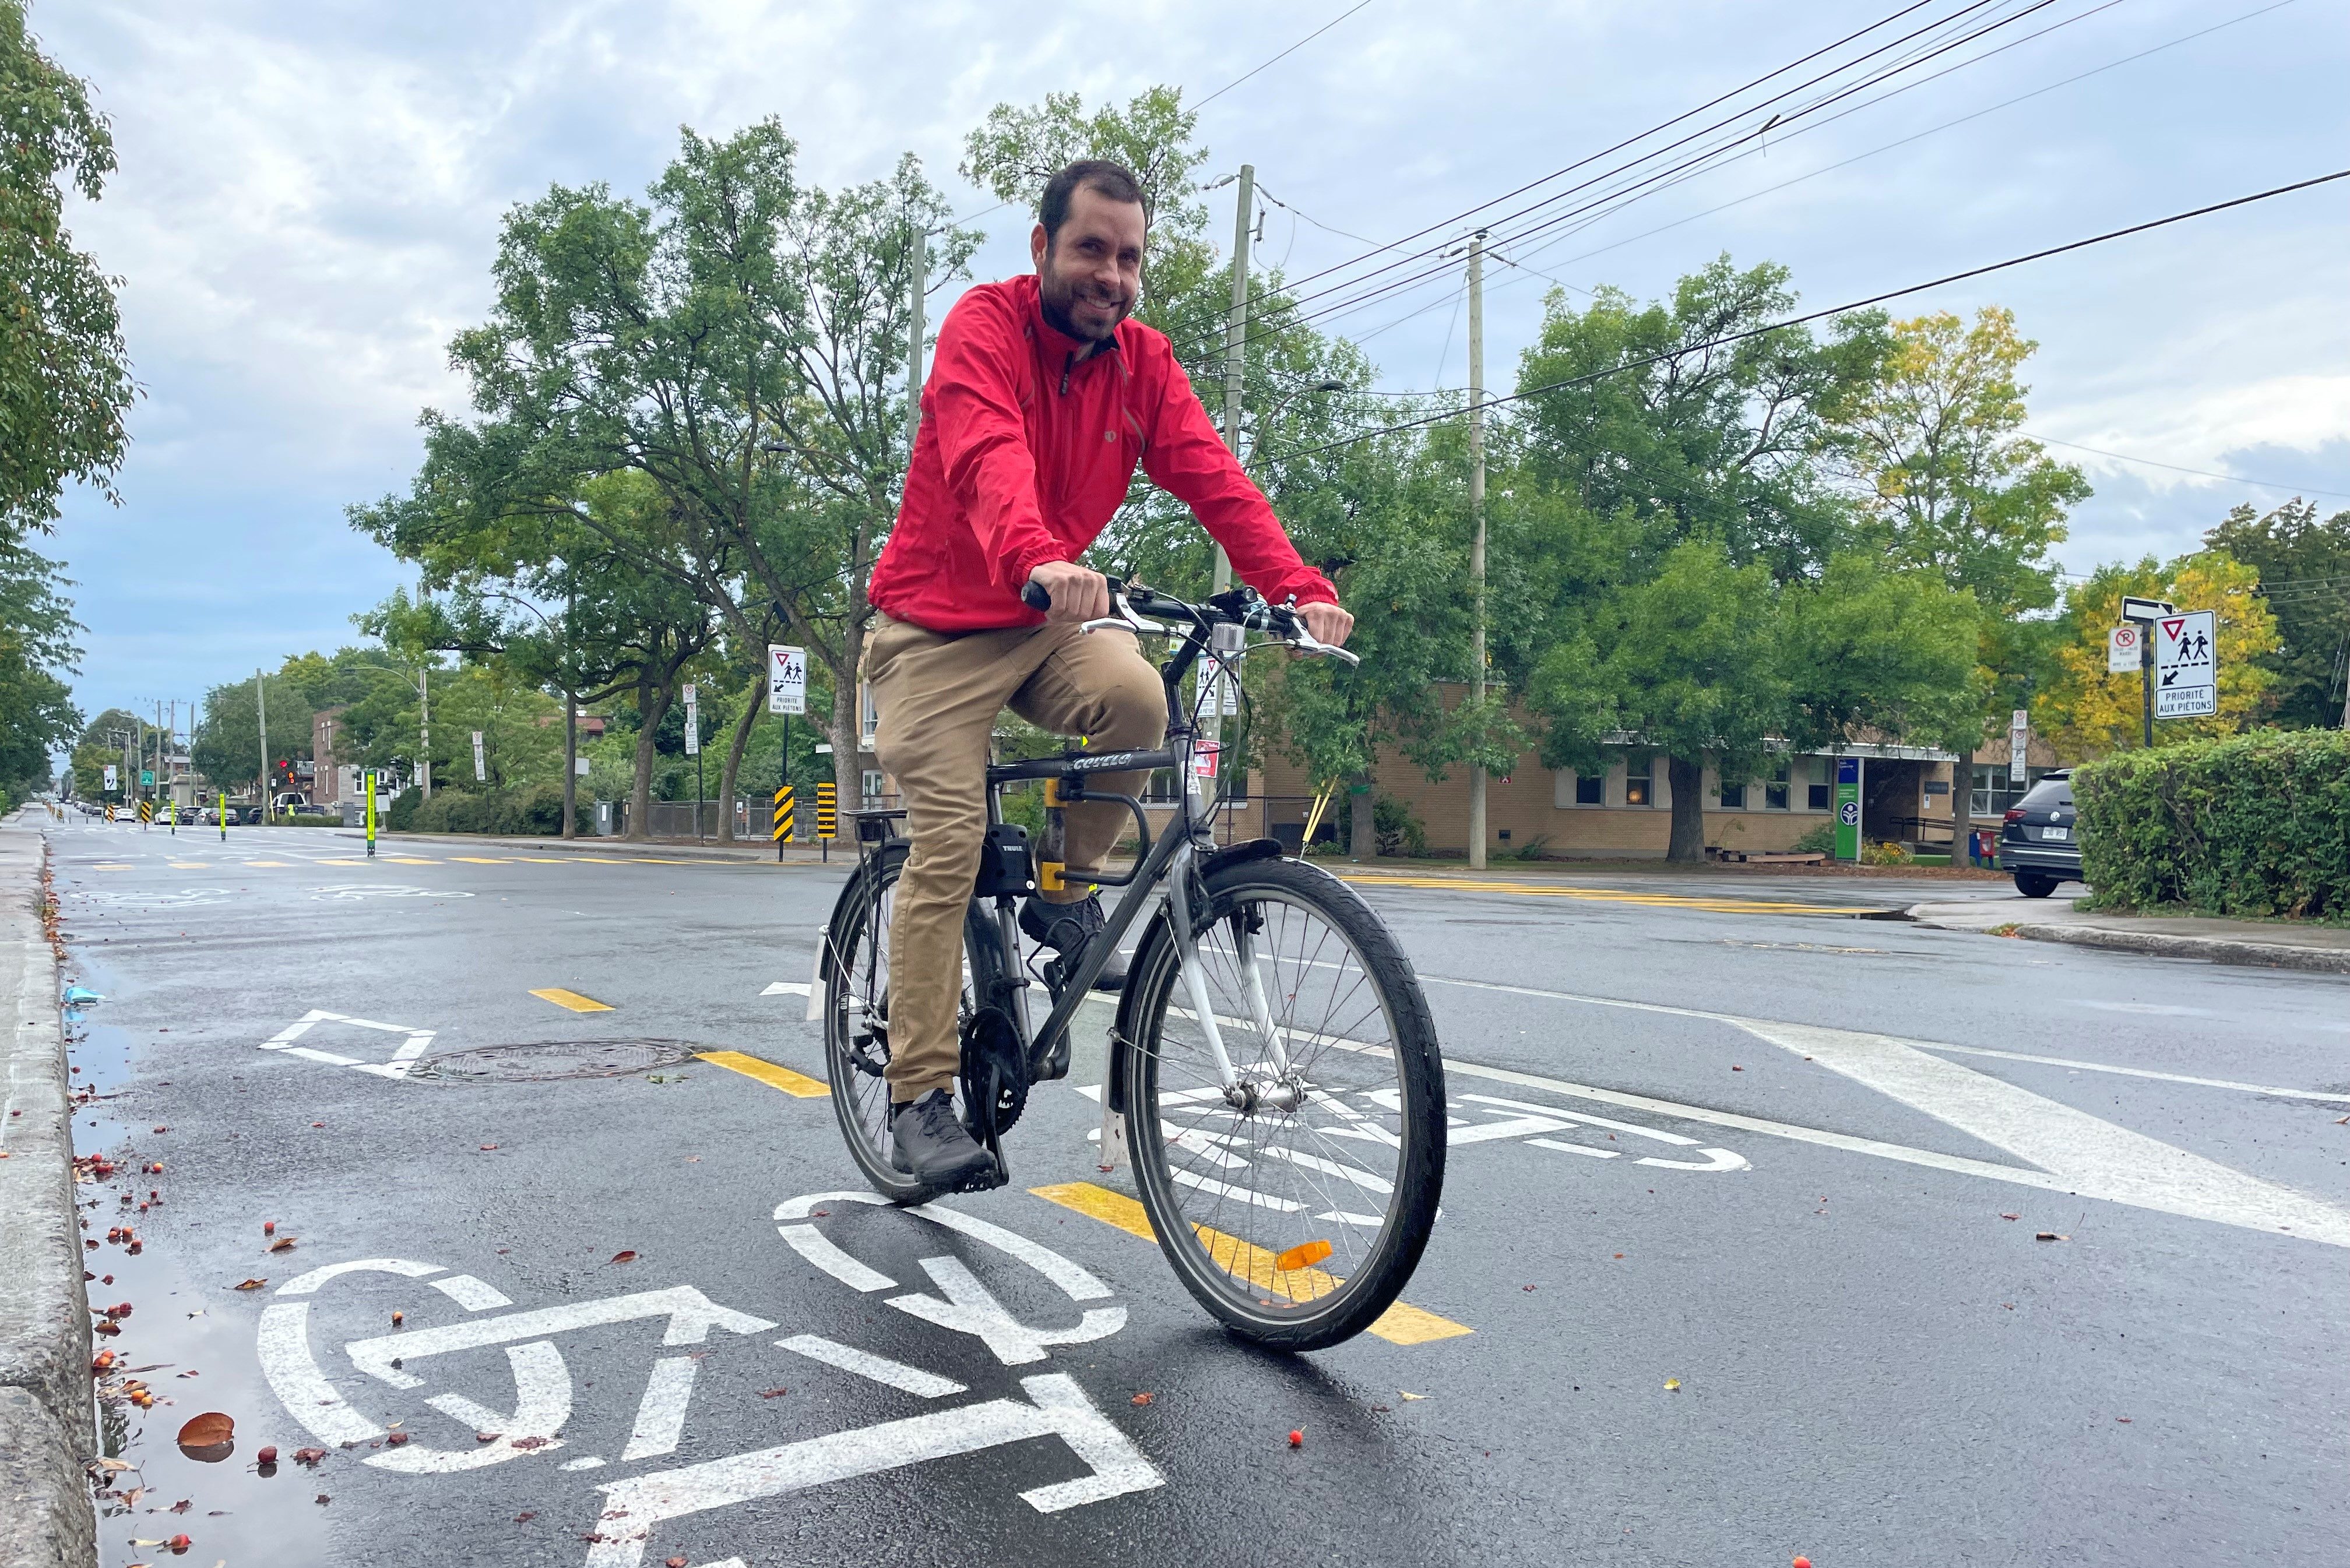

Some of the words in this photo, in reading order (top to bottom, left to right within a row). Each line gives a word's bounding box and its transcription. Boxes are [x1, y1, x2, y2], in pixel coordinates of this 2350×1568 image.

[2166, 689, 2204, 702] PRIORITÉ
[2159, 703, 2175, 713] AUX
[2178, 700, 2212, 711] PIÉTONS
